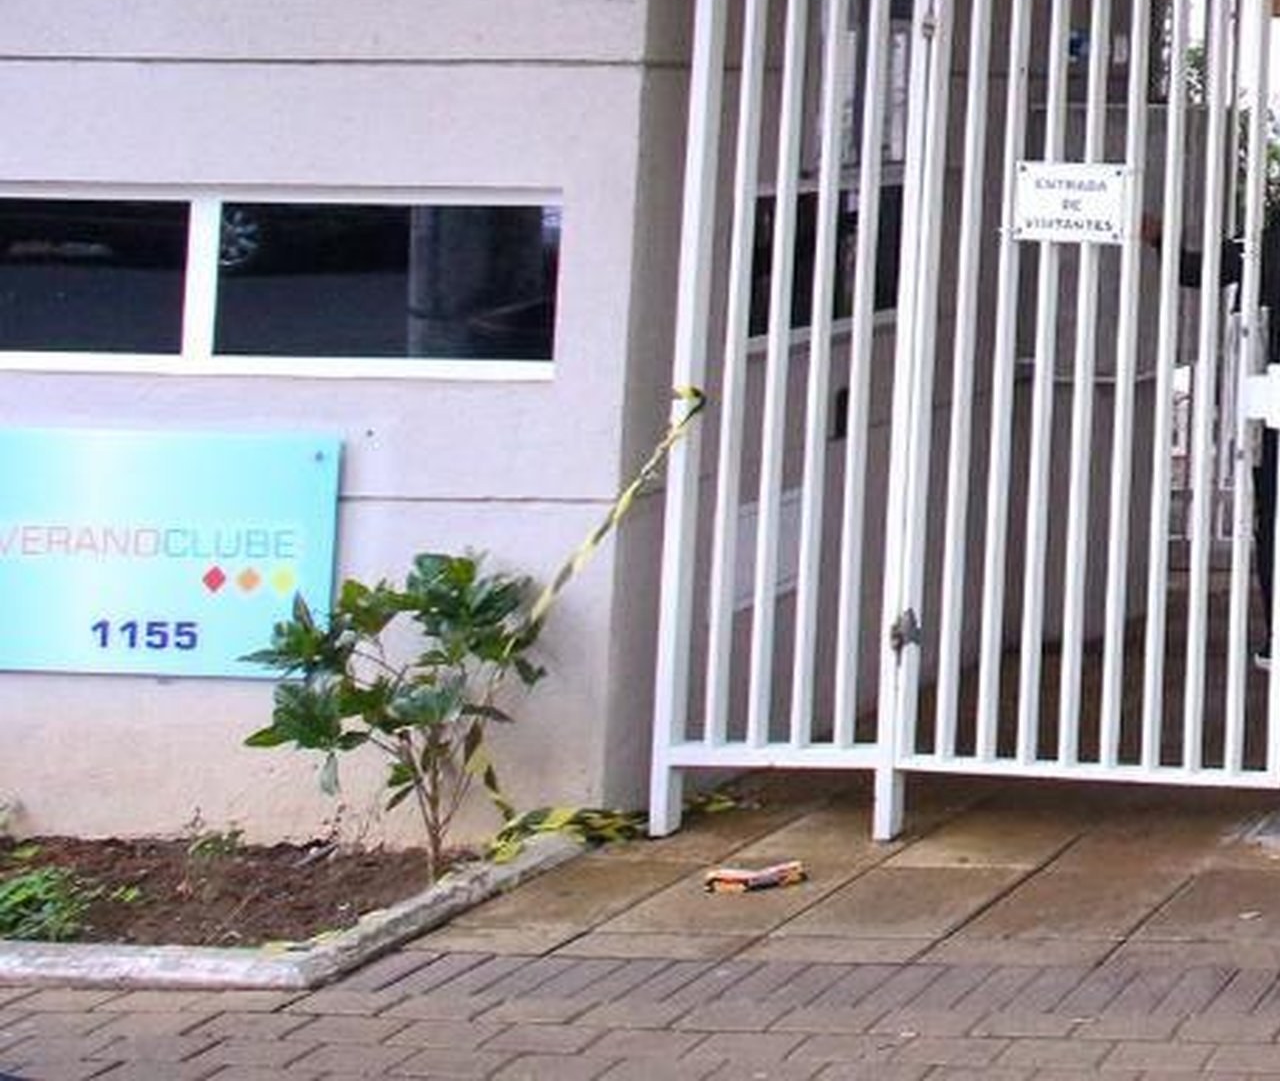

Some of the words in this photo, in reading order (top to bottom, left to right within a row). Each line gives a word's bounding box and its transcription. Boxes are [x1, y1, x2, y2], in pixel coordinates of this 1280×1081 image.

[1034, 178, 1108, 194] ENTRADA
[1062, 198, 1082, 213] DE
[1024, 216, 1114, 232] VISITANTES
[0, 525, 295, 559] VERANOCLUBE
[90, 618, 200, 650] 1155
